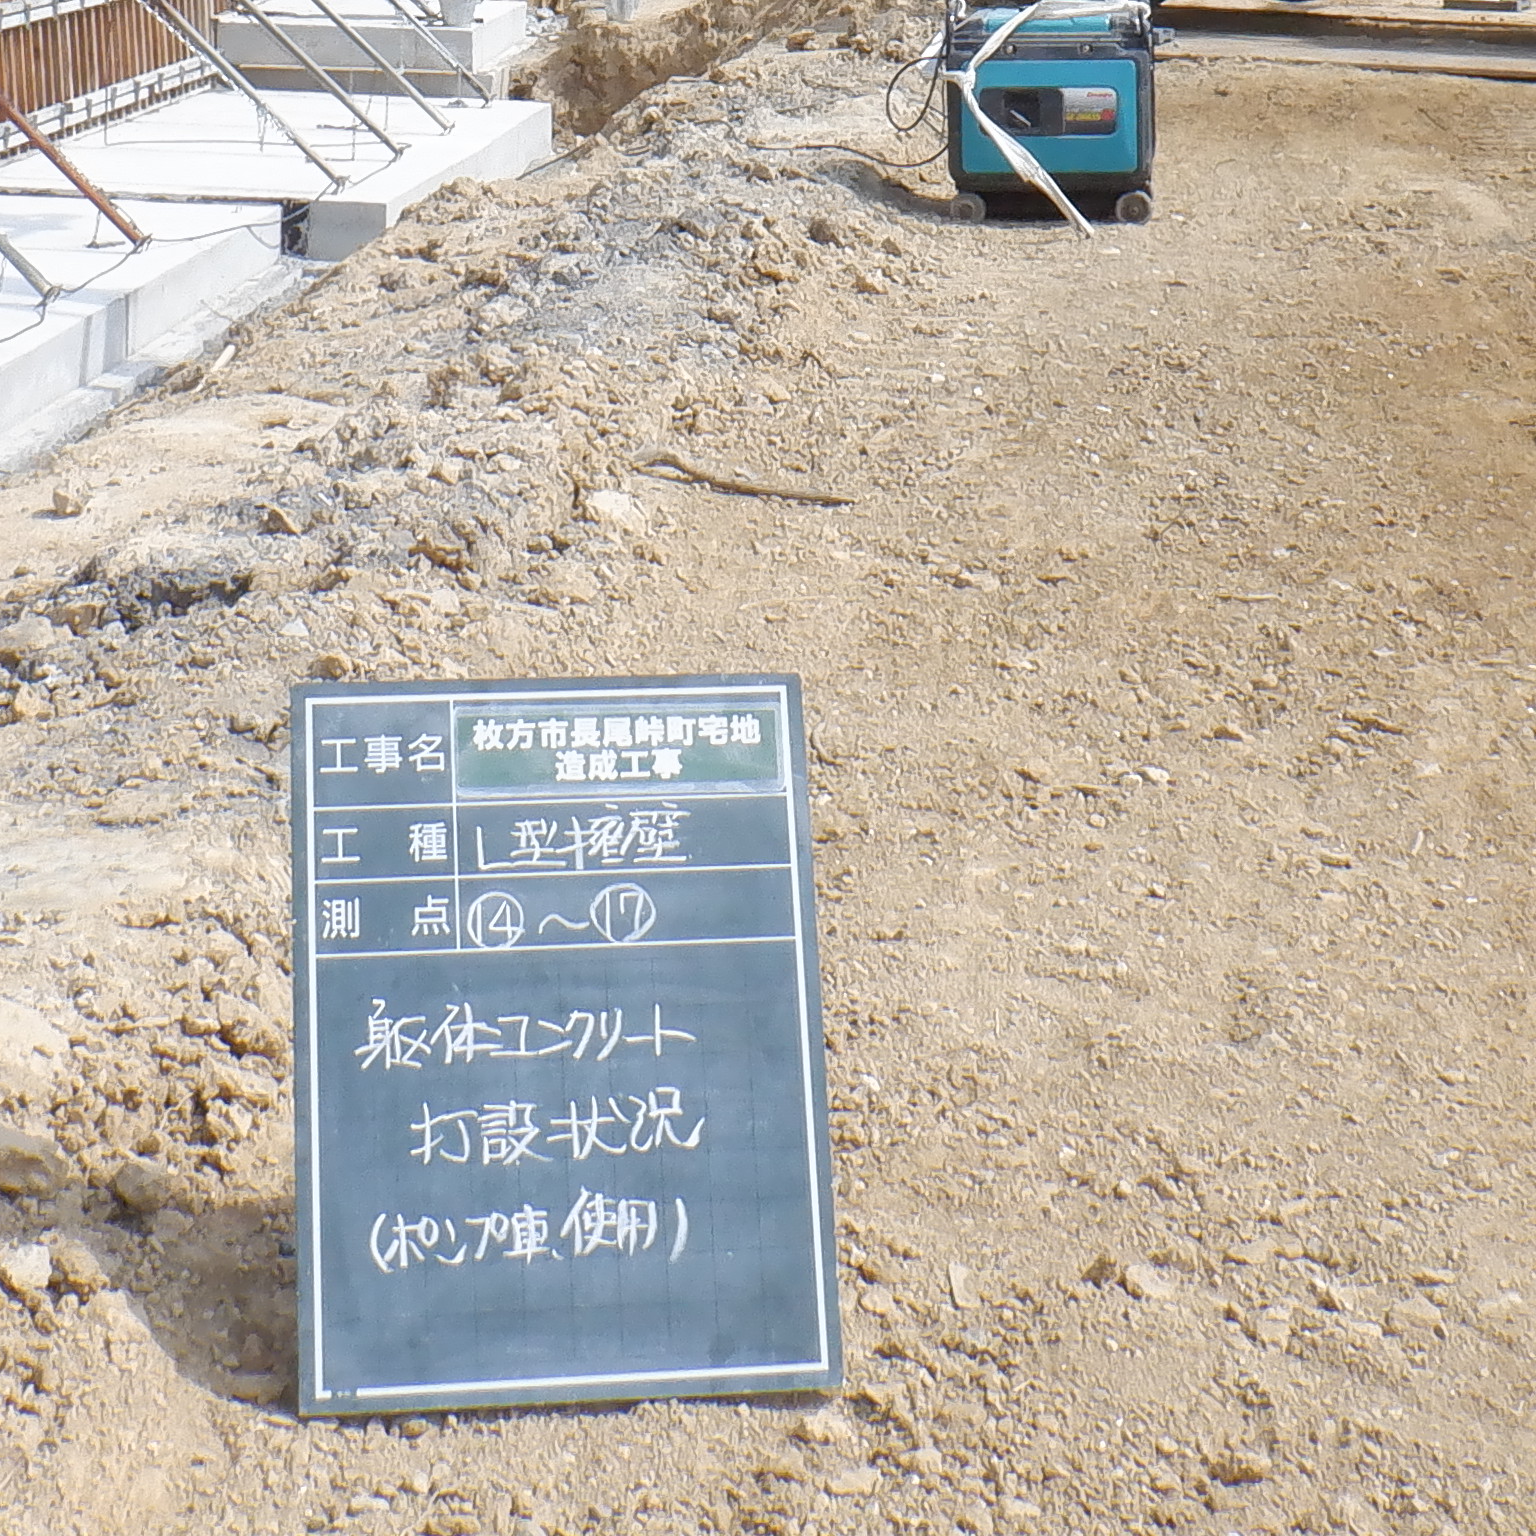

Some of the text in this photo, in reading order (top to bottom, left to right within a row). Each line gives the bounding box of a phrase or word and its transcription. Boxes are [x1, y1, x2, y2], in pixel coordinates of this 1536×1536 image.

[472, 713, 762, 752] 枚方市長尾峠町宅地
[319, 733, 446, 774] 工事名
[555, 747, 683, 782] 造成工事
[353, 998, 697, 1070] 躯体コンクリート
[409, 1085, 705, 1165] 打設状況
